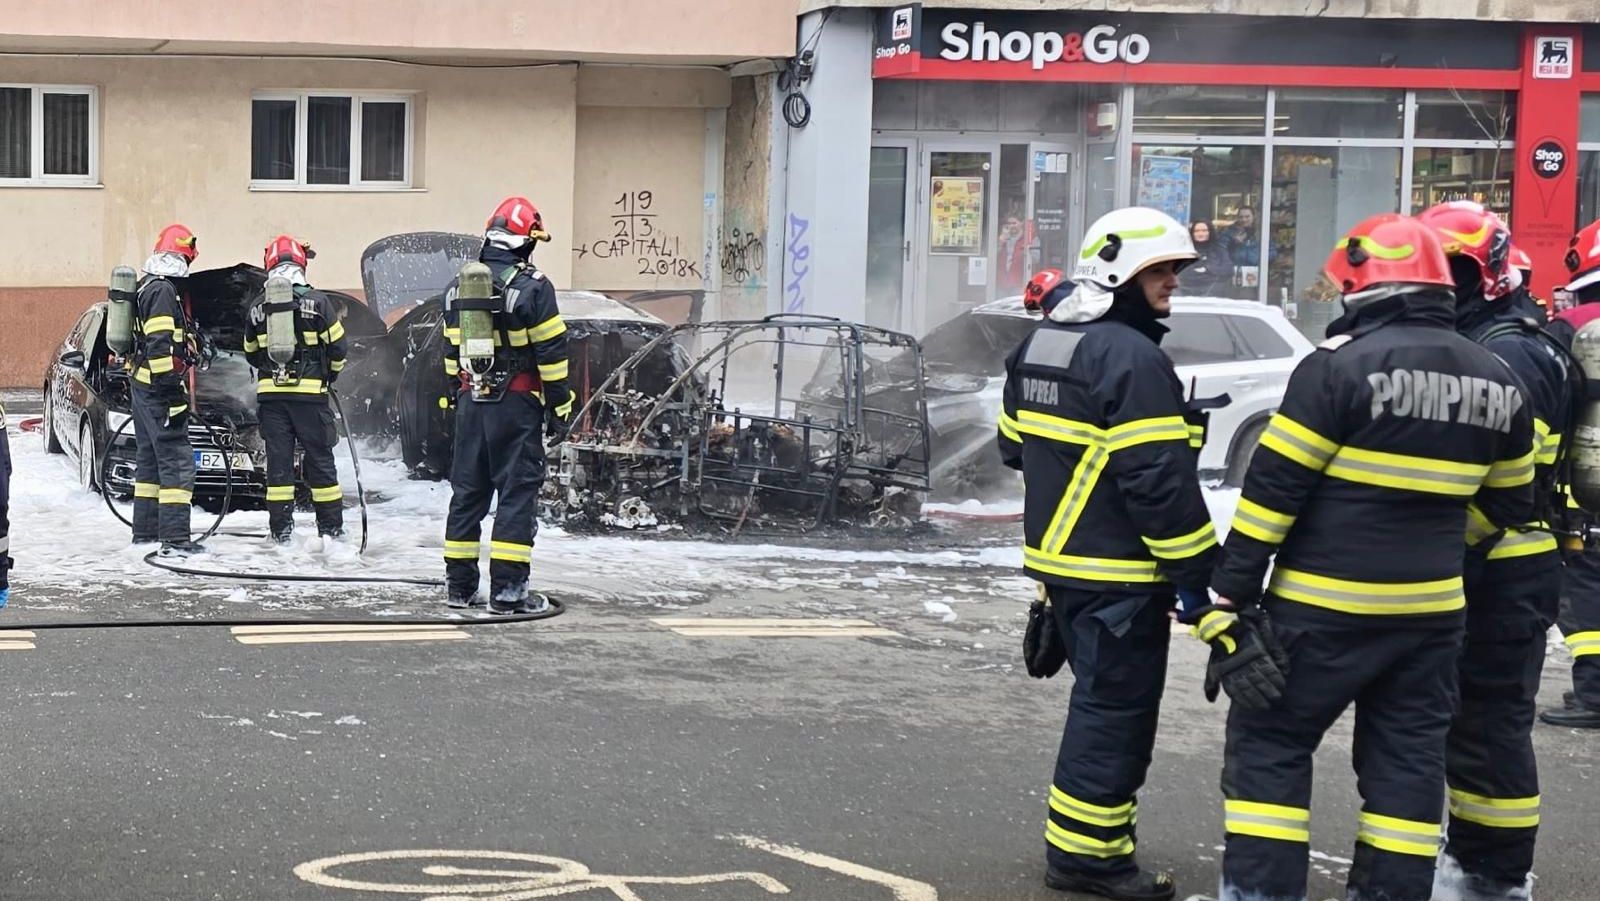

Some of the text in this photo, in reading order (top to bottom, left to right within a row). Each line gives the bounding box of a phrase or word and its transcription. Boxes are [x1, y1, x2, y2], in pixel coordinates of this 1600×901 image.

[876, 46, 897, 59] Shop
[940, 22, 1150, 70] Shop&Go
[1535, 149, 1563, 162] Shop
[614, 218, 653, 238] 2 3
